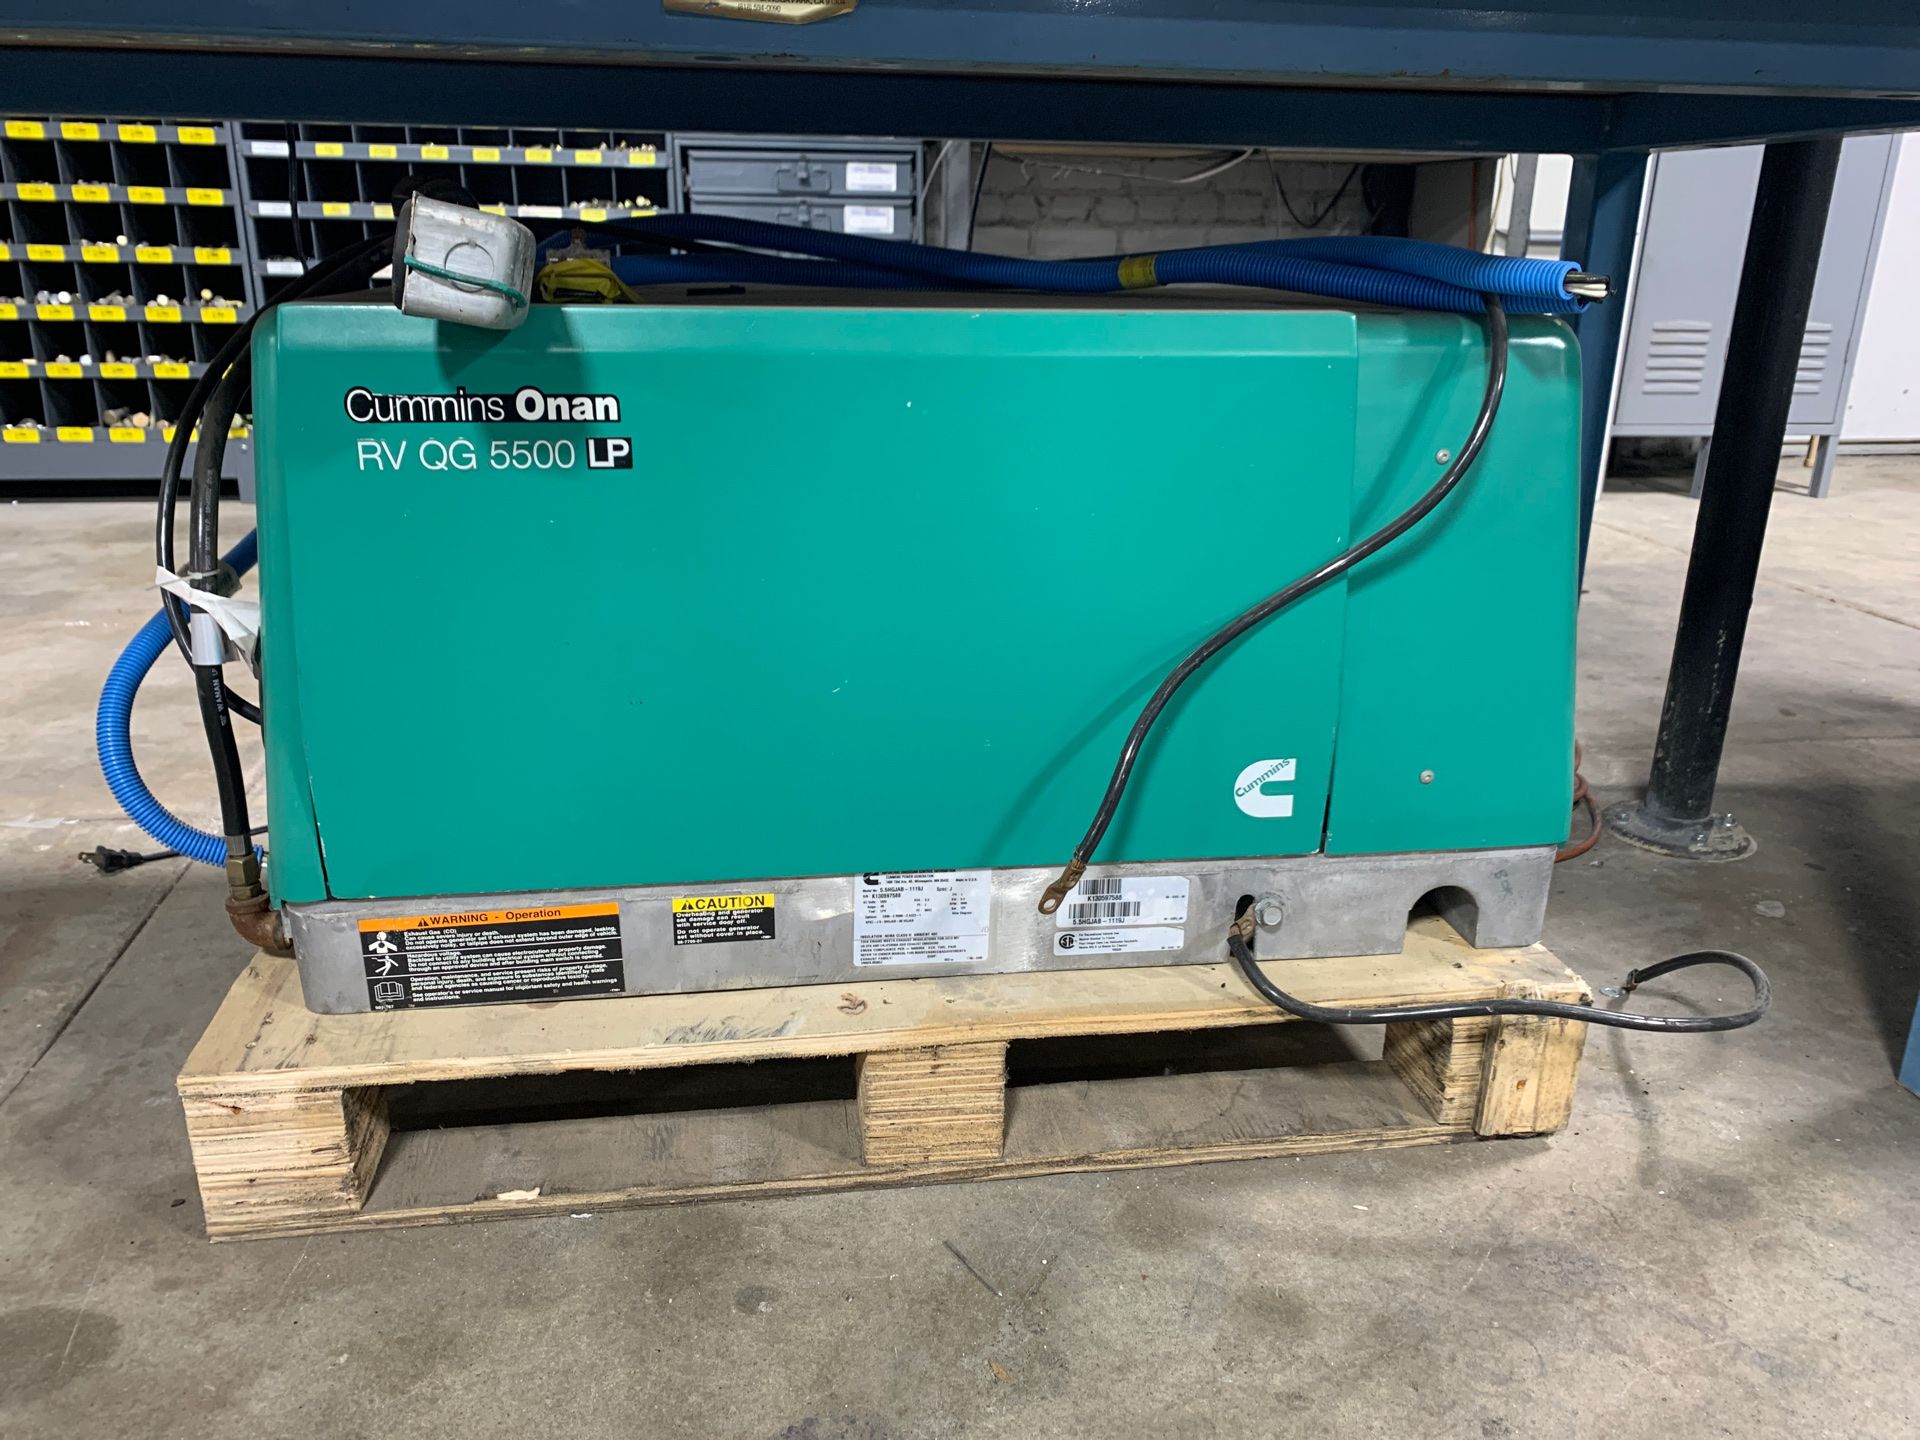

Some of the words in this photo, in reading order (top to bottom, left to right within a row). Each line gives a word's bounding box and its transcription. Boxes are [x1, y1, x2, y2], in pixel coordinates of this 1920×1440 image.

[347, 388, 505, 421] Cummins
[516, 388, 619, 421] Onan
[357, 438, 406, 470] RV
[419, 438, 476, 471] QG
[490, 440, 575, 469] 5500
[588, 440, 630, 468] LP
[1235, 759, 1290, 797] Cummins
[430, 913, 488, 925] WARNING
[505, 908, 561, 921] Operation
[696, 896, 764, 909] CAUTION
